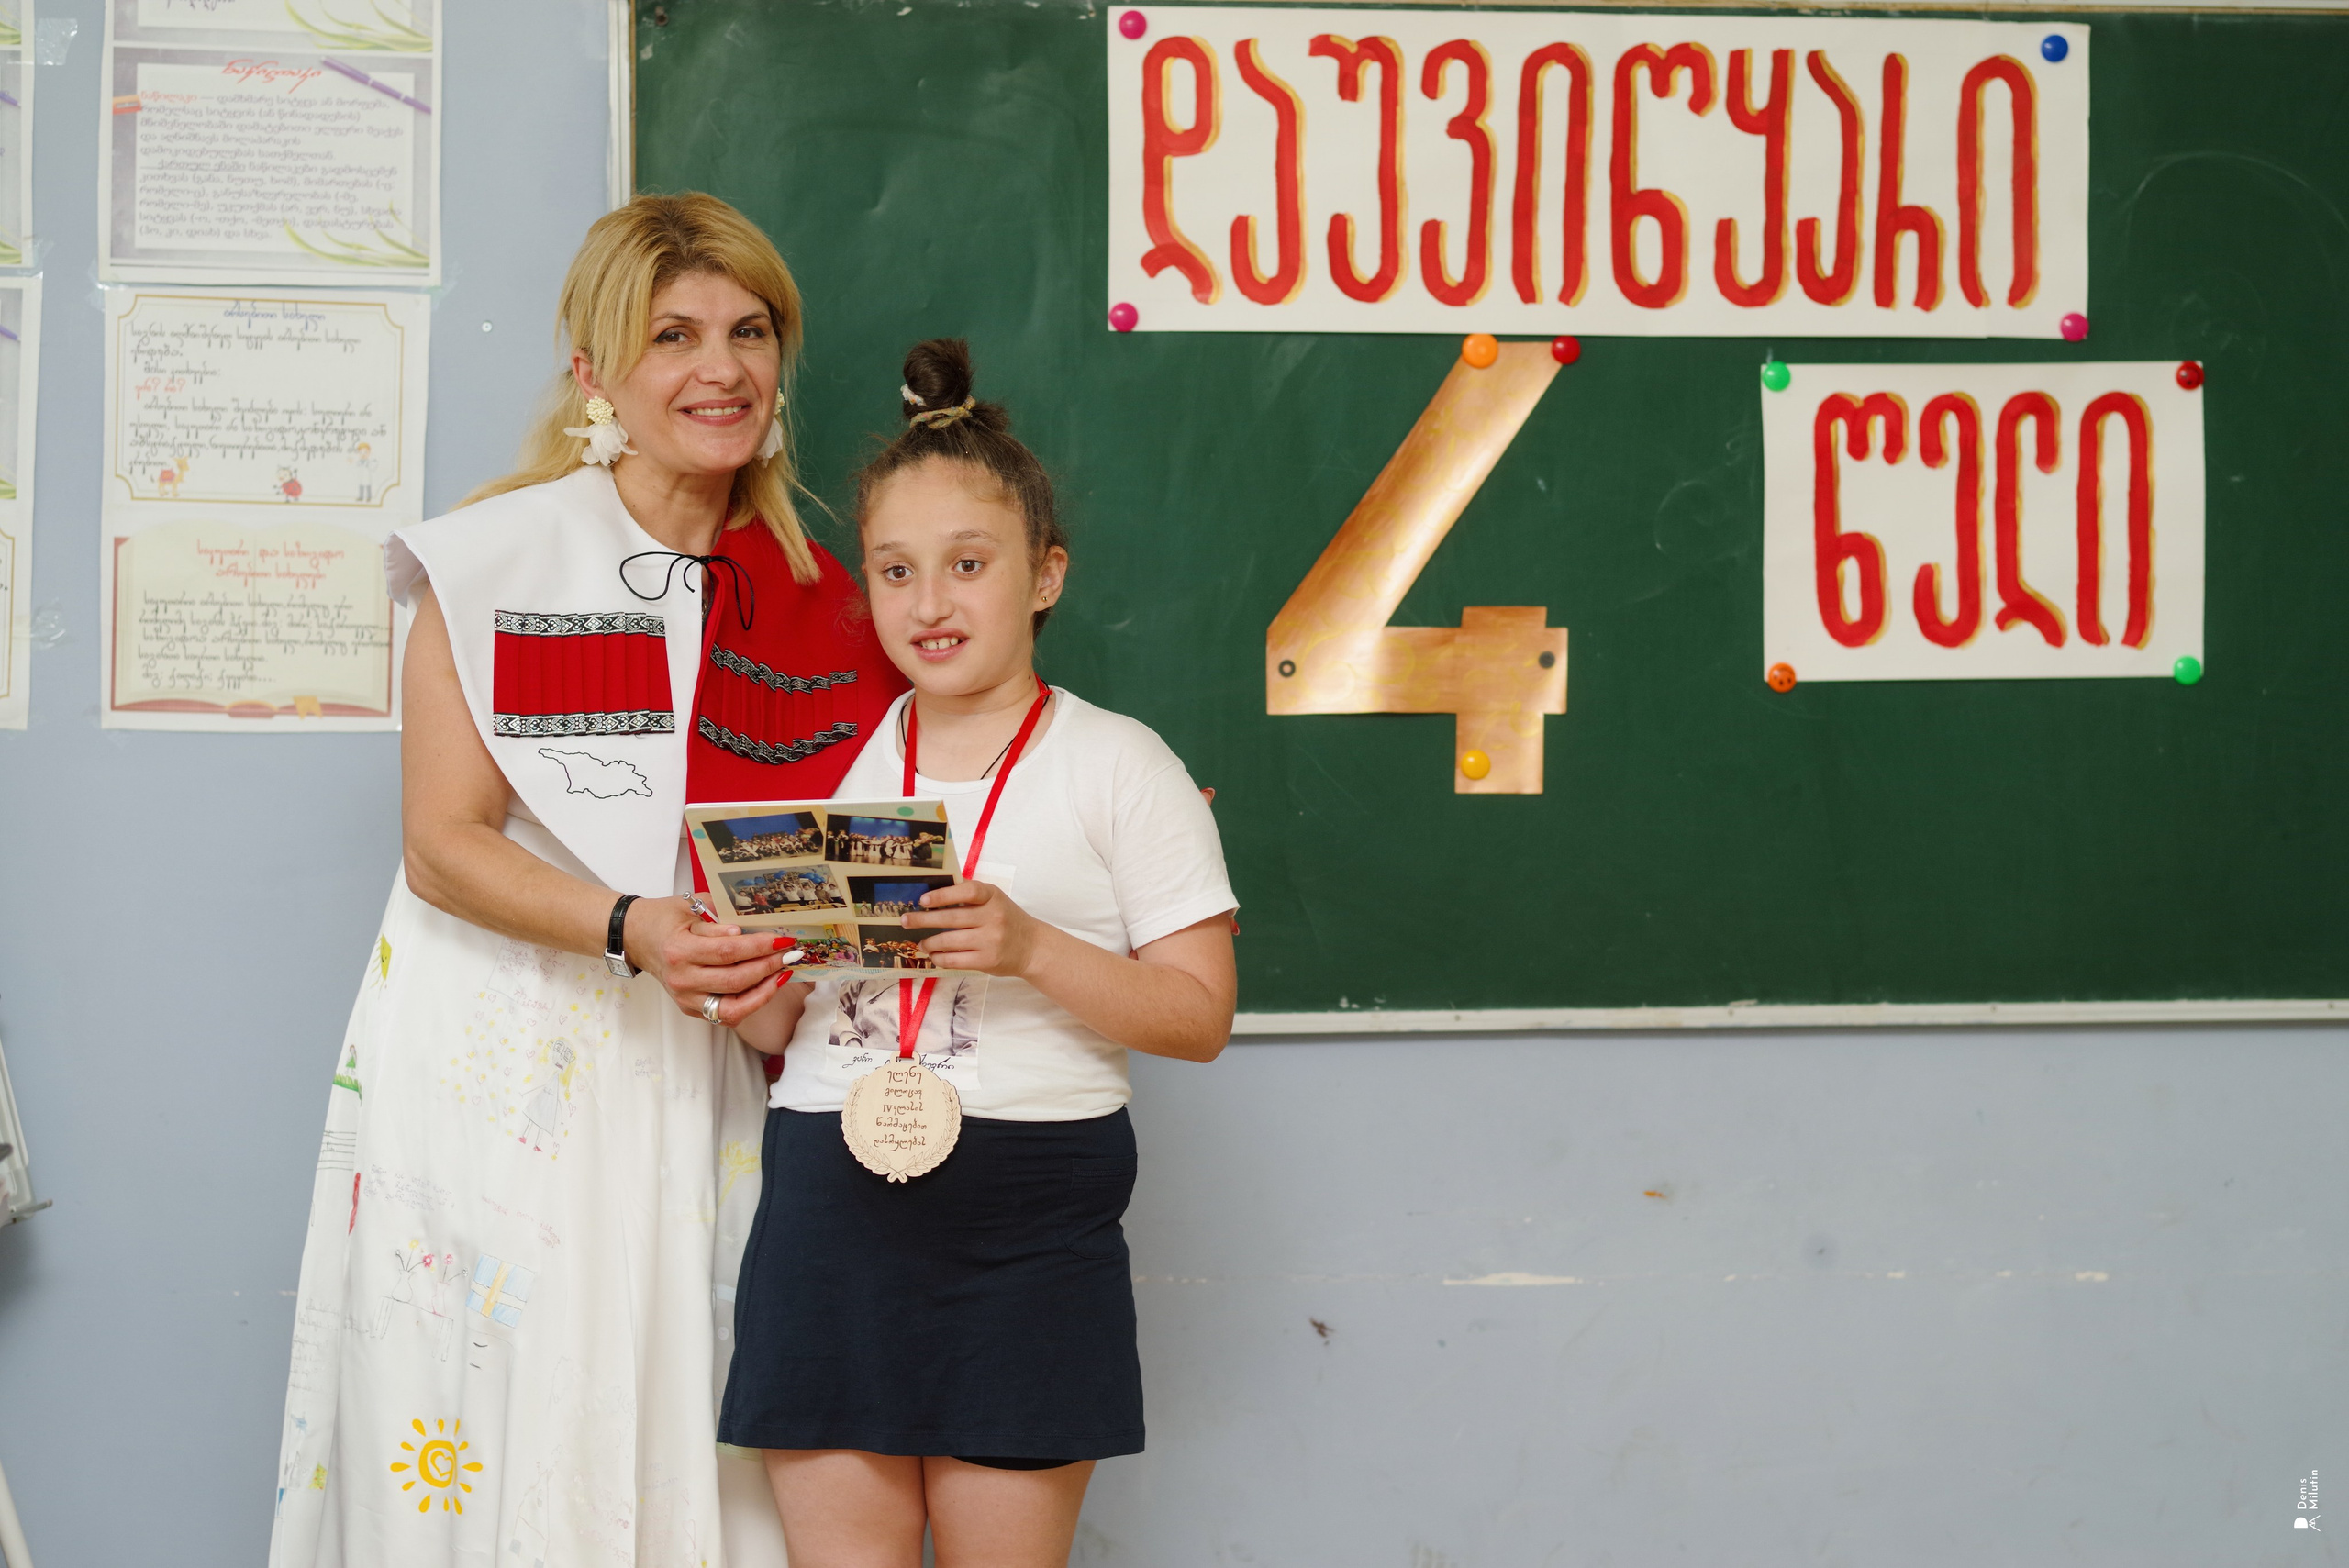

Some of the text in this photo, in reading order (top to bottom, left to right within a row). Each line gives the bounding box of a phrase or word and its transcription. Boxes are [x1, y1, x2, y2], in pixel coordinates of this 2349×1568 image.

[221, 59, 322, 94] ნაწილაკი
[140, 90, 198, 103] ნაწილაკი
[140, 133, 157, 142] და
[1141, 33, 2041, 313] დაუვიწყარი
[281, 301, 326, 332] სახელი
[196, 539, 250, 566] საკუთარი
[258, 548, 279, 563] და
[1266, 341, 2156, 795] 4 წელი
[887, 1065, 922, 1085] ელენე
[875, 1116, 928, 1134] წარმატებით
[873, 1133, 927, 1152] დასრულებას
